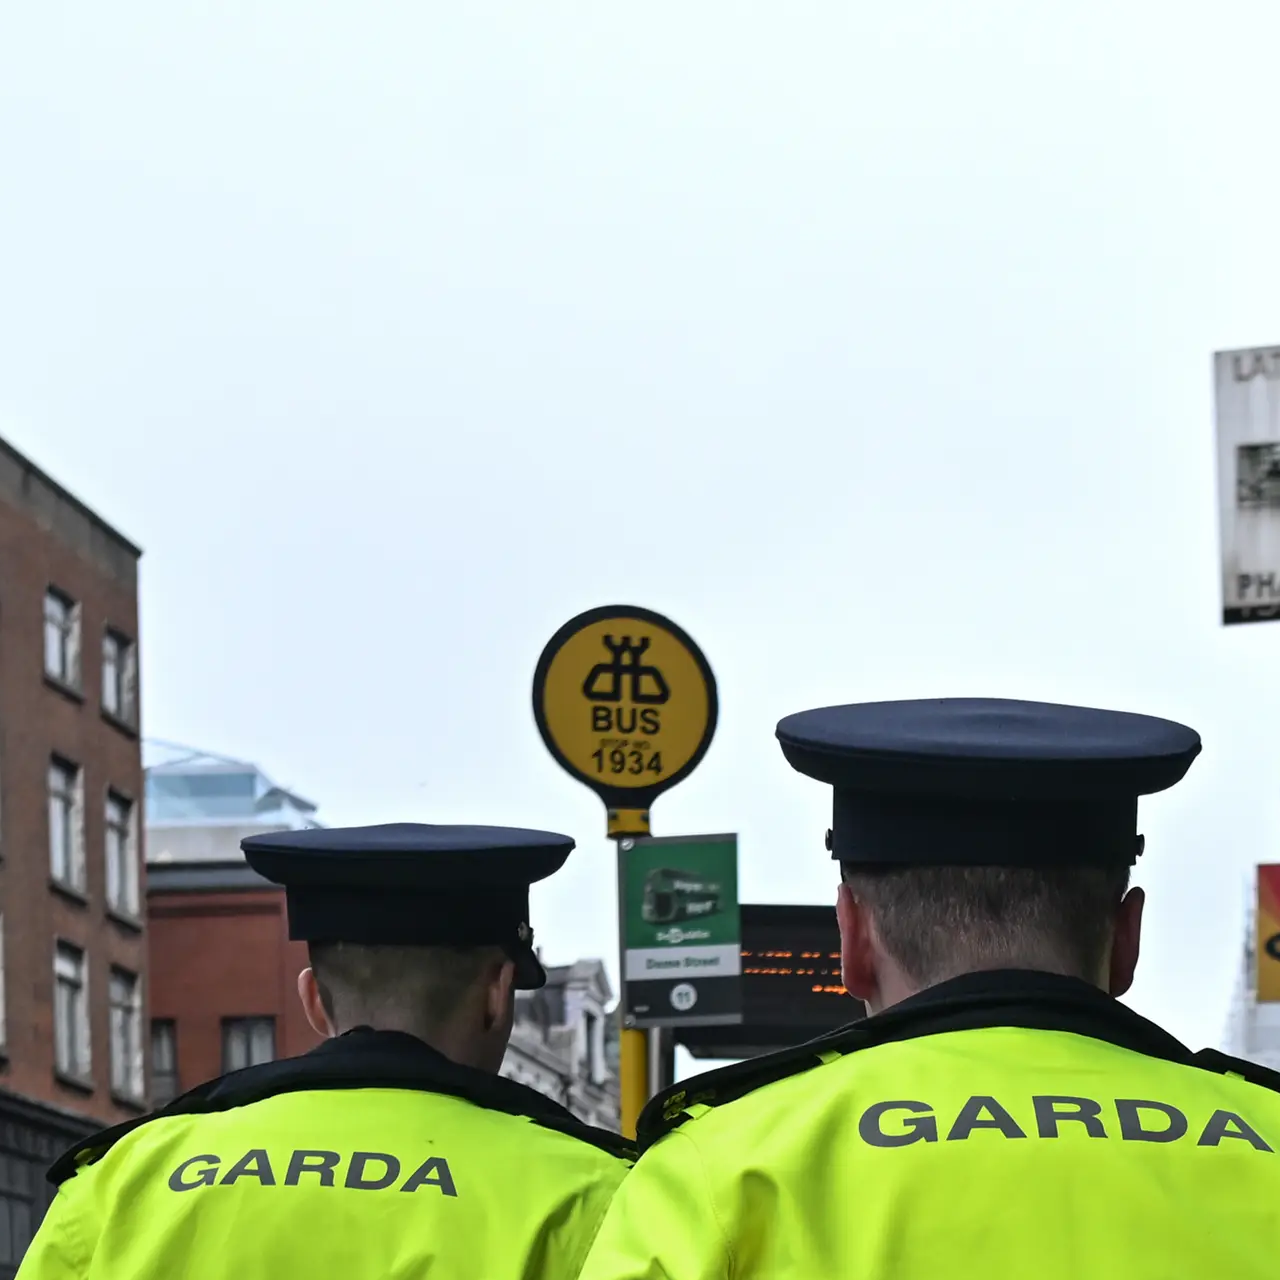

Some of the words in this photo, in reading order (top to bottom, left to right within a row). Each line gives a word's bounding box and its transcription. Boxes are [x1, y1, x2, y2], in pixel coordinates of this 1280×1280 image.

[592, 705, 661, 735] BUS
[591, 749, 664, 776] 1934
[858, 1095, 1275, 1154] GARDA
[168, 1148, 458, 1198] GARDA
